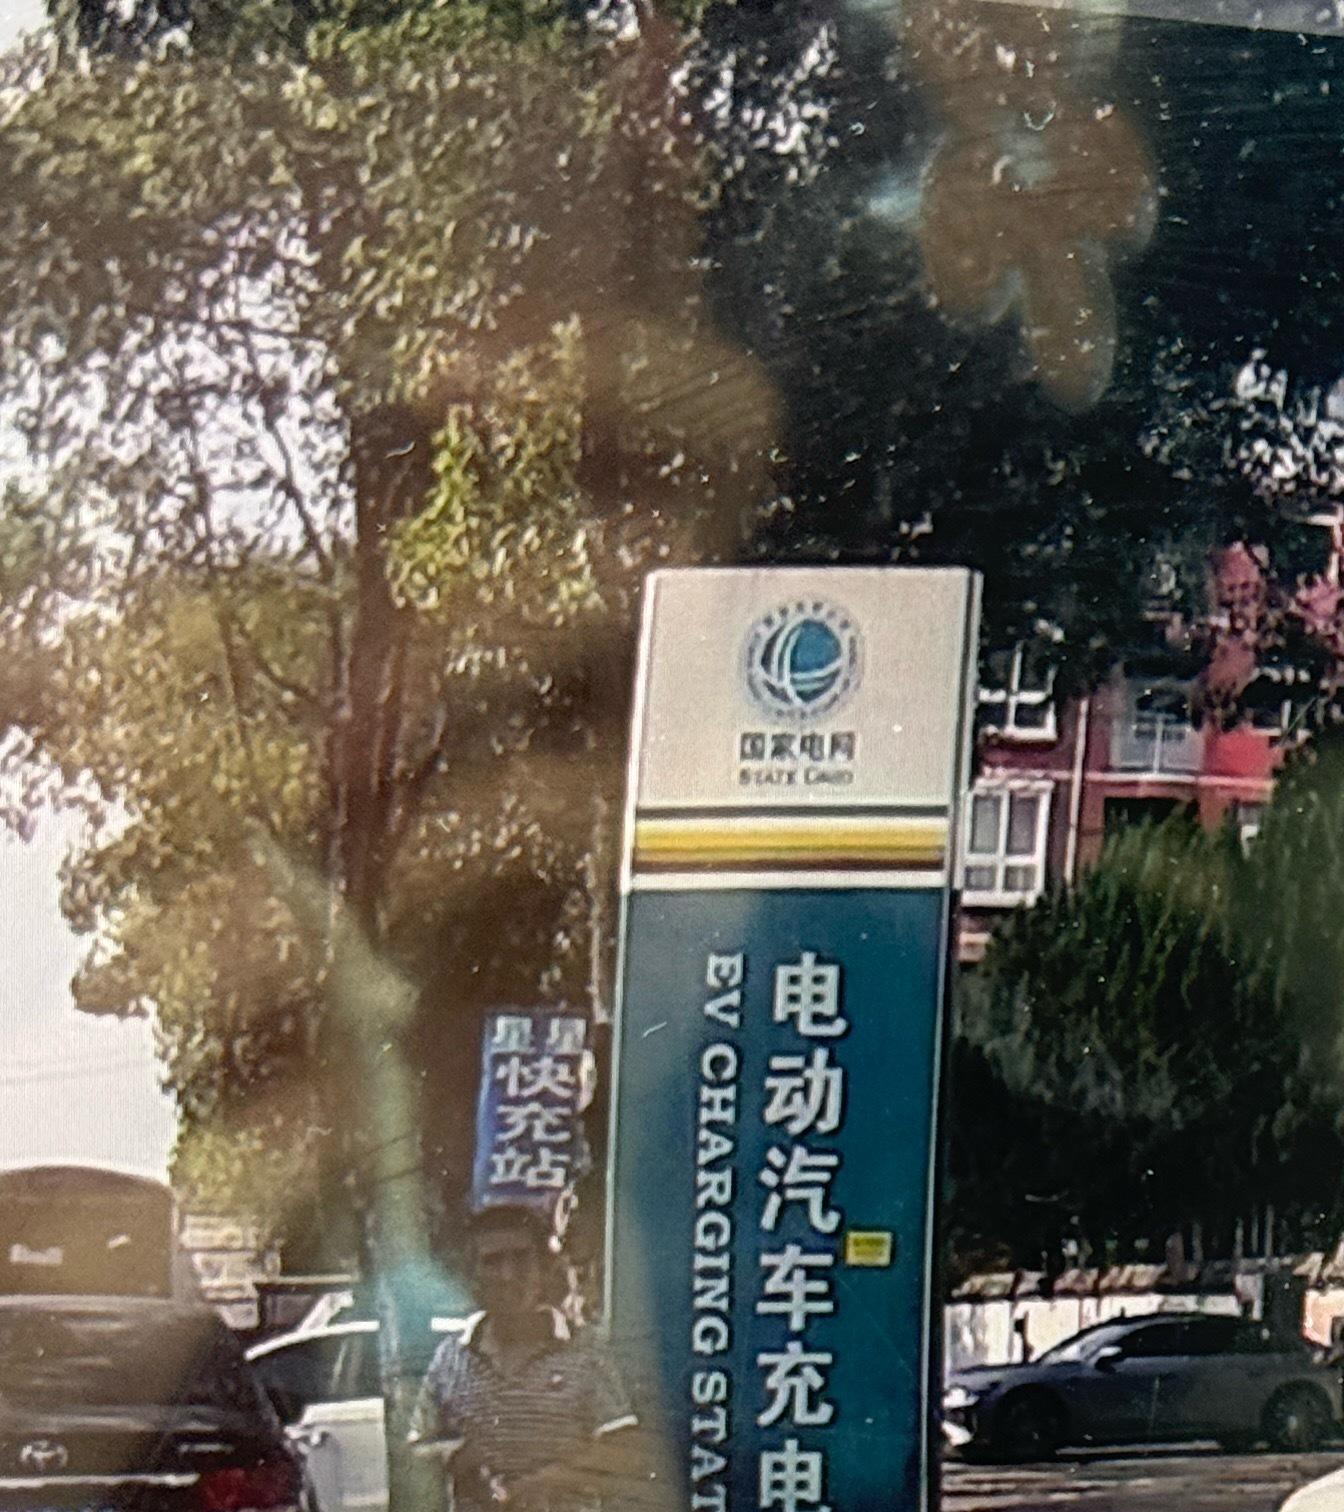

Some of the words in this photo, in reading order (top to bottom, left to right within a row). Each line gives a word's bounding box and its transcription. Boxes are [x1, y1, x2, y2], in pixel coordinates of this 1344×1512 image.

[739, 731, 855, 762] 国家电网
[703, 952, 746, 1031] EV
[489, 1055, 578, 1189] 快充站
[692, 1043, 740, 1354] CHARGING
